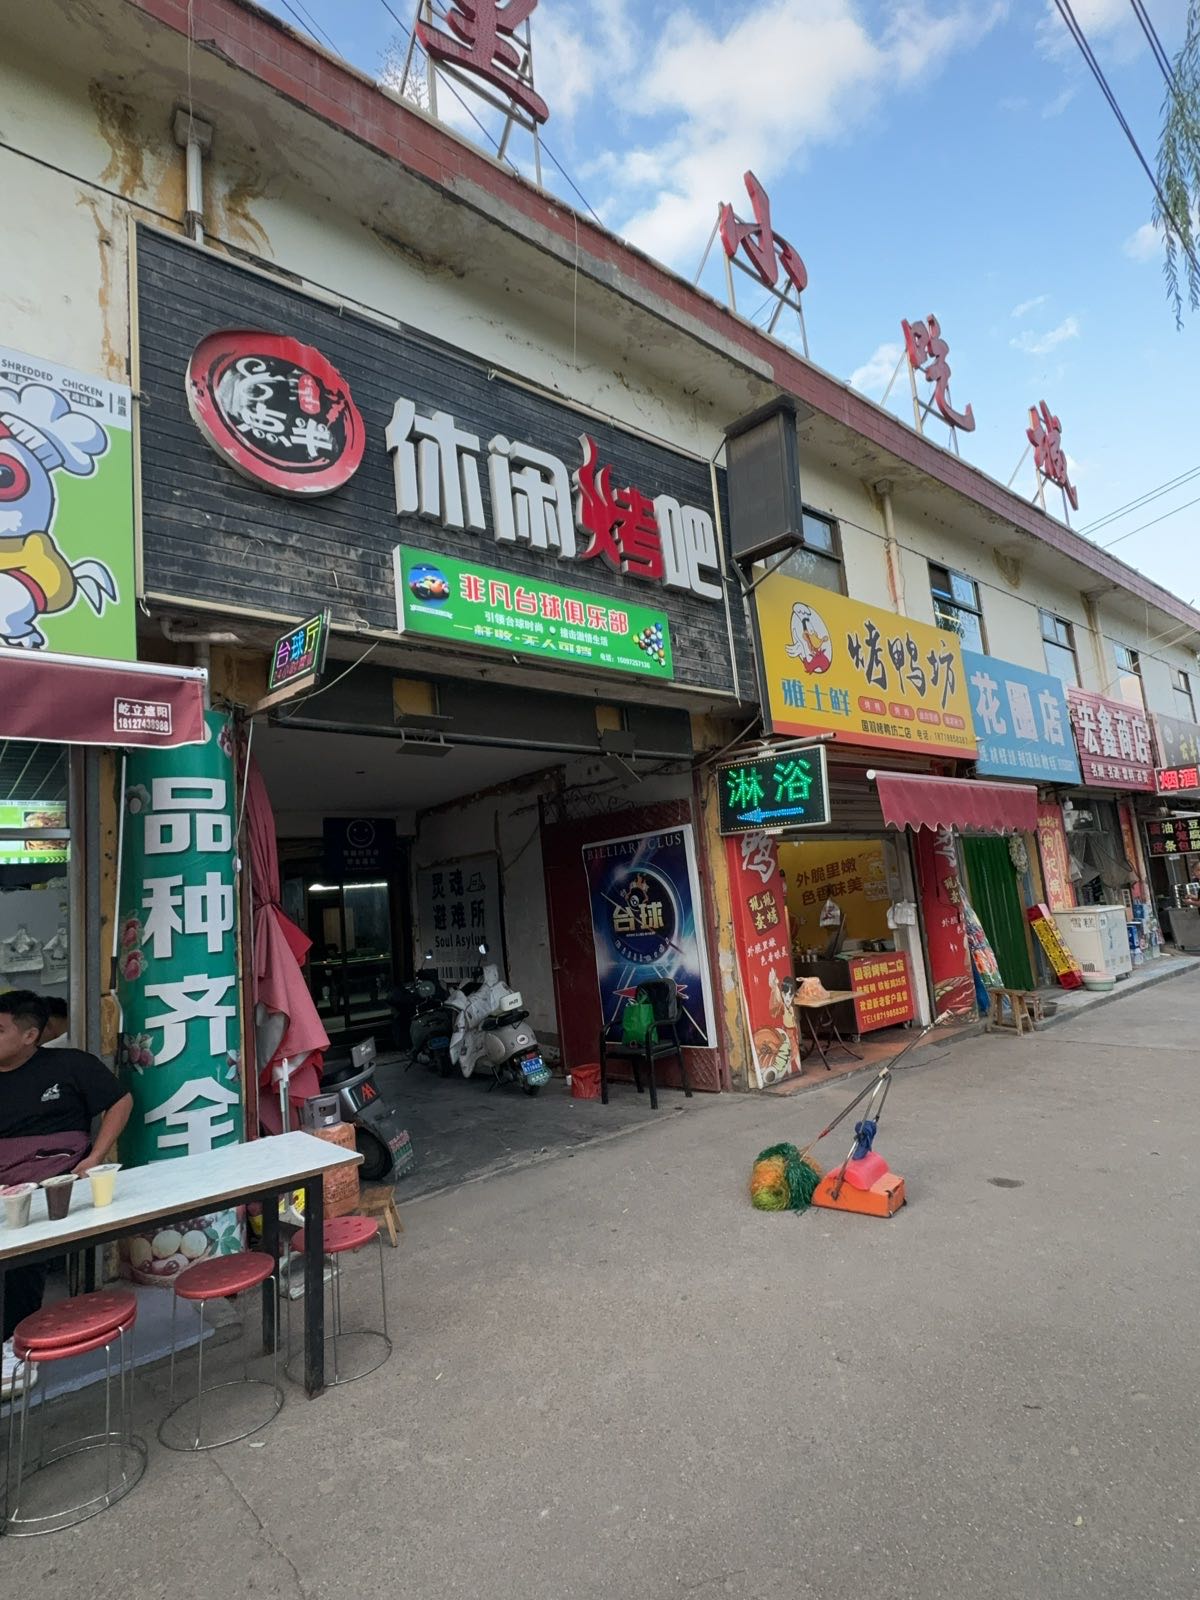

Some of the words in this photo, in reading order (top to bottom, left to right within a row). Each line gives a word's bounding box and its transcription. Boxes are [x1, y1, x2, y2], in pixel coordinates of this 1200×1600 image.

[1, 358, 53, 382] SHREDDED
[62, 378, 103, 398] CHICKEN
[385, 396, 724, 602] 休闲烤吧
[459, 572, 630, 635] 非凡台球俱乐部
[277, 620, 320, 668] 台球厅
[847, 620, 957, 708] 烤鸭坊
[118, 702, 168, 718] 屹立遮阳
[781, 678, 851, 717] 雅士鲜
[971, 671, 1064, 745] 花圈店
[726, 759, 813, 808] 淋浴
[1160, 768, 1198, 790] 烟酒
[1162, 822, 1177, 852] 油条
[432, 870, 465, 899] 灵魂
[796, 857, 857, 888] 外脆里嫩
[433, 899, 485, 930] 避难所
[612, 902, 664, 931] 台球
[435, 935, 453, 947] Soul
[142, 776, 240, 1163] 品种齐全
